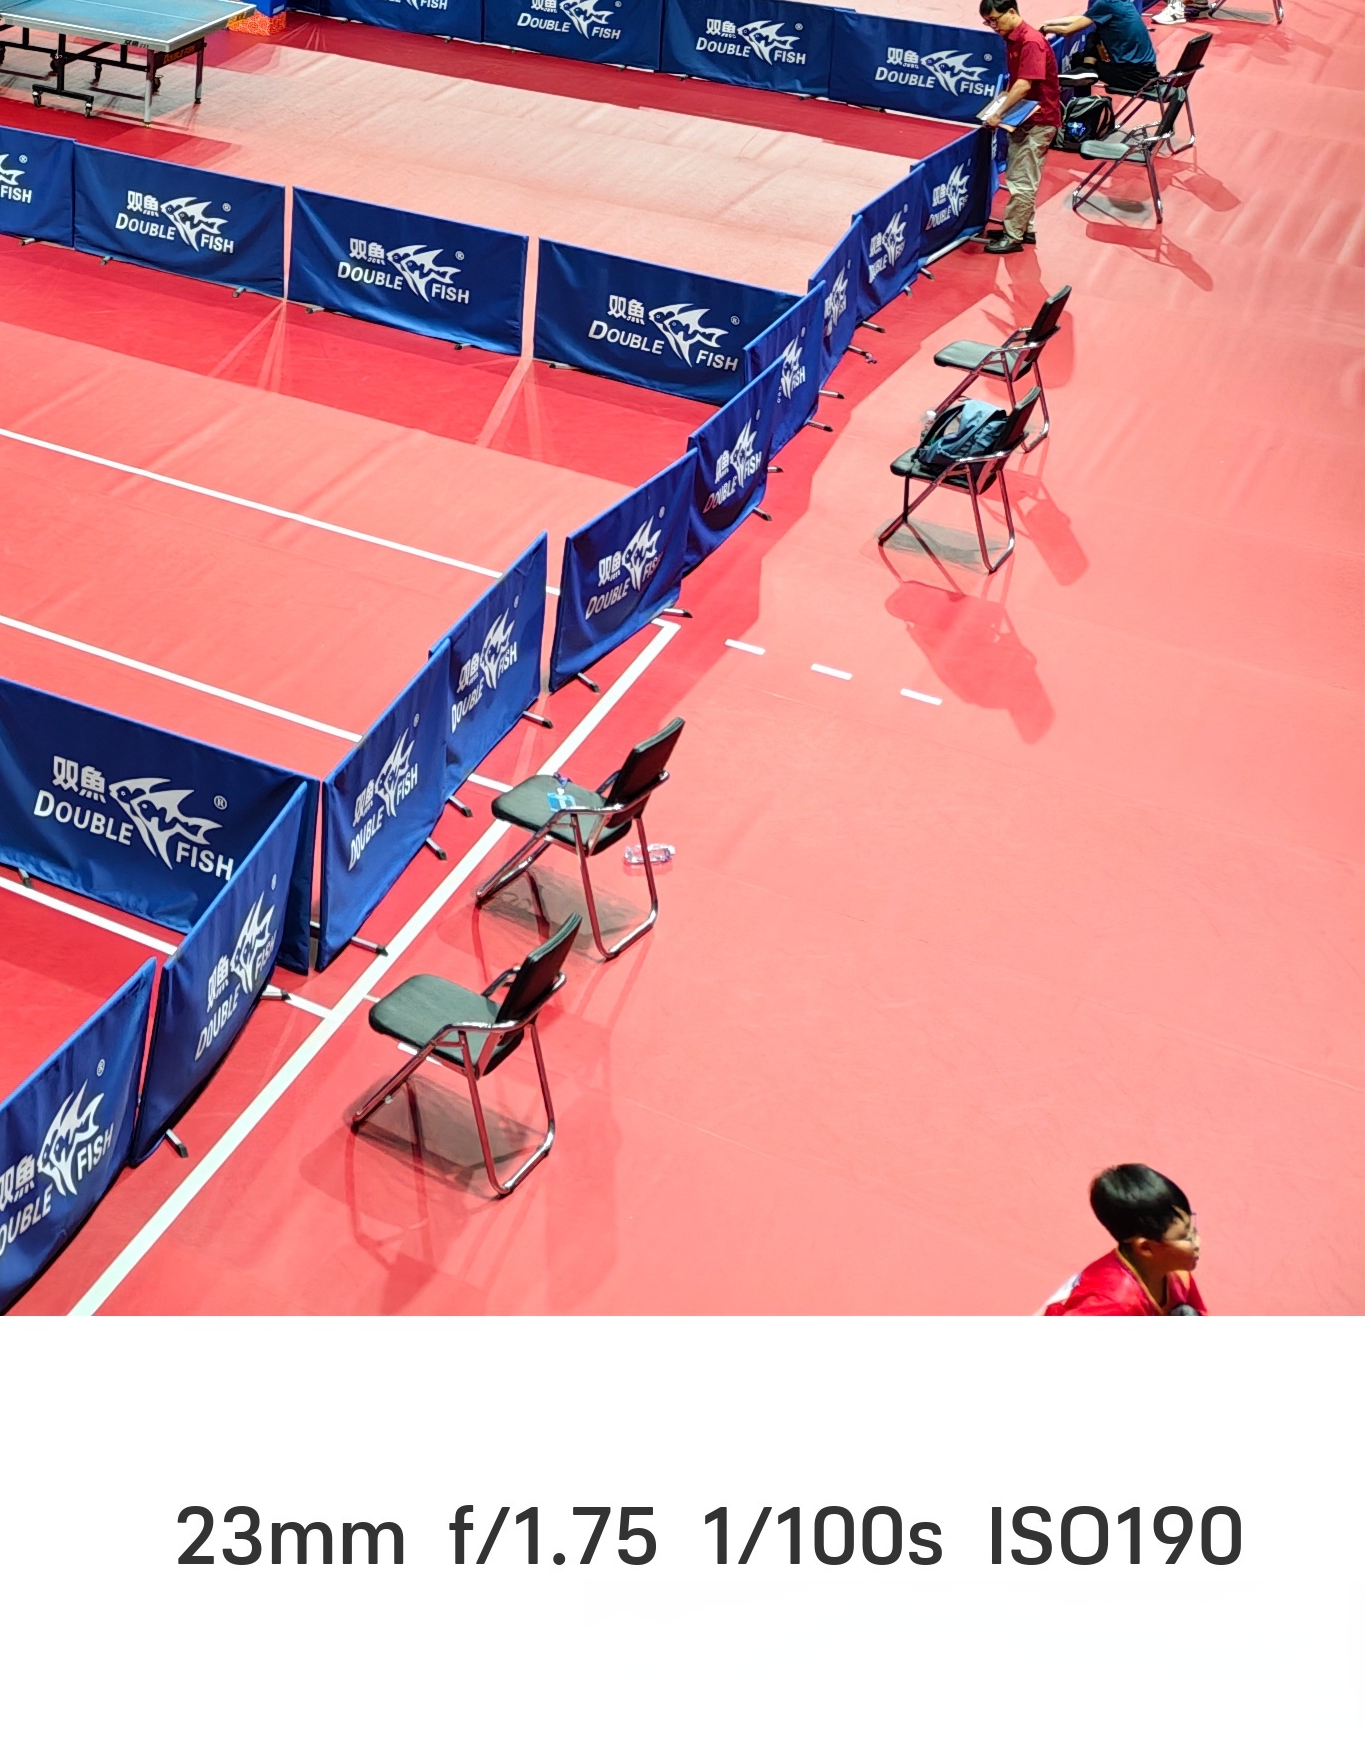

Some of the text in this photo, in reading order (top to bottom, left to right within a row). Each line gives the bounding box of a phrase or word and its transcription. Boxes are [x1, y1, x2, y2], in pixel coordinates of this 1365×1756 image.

[696, 33, 806, 65] DOUBLE FISH
[875, 62, 995, 97] DOUBLE FISH
[0, 185, 32, 203] FISH
[115, 209, 234, 253] DOUBLE FISH
[338, 259, 469, 304] DOUBLE FISH
[588, 316, 738, 371] DOUBLE FISH
[33, 789, 233, 881] DOUBLE FISH
[77, 1123, 114, 1180] FISH
